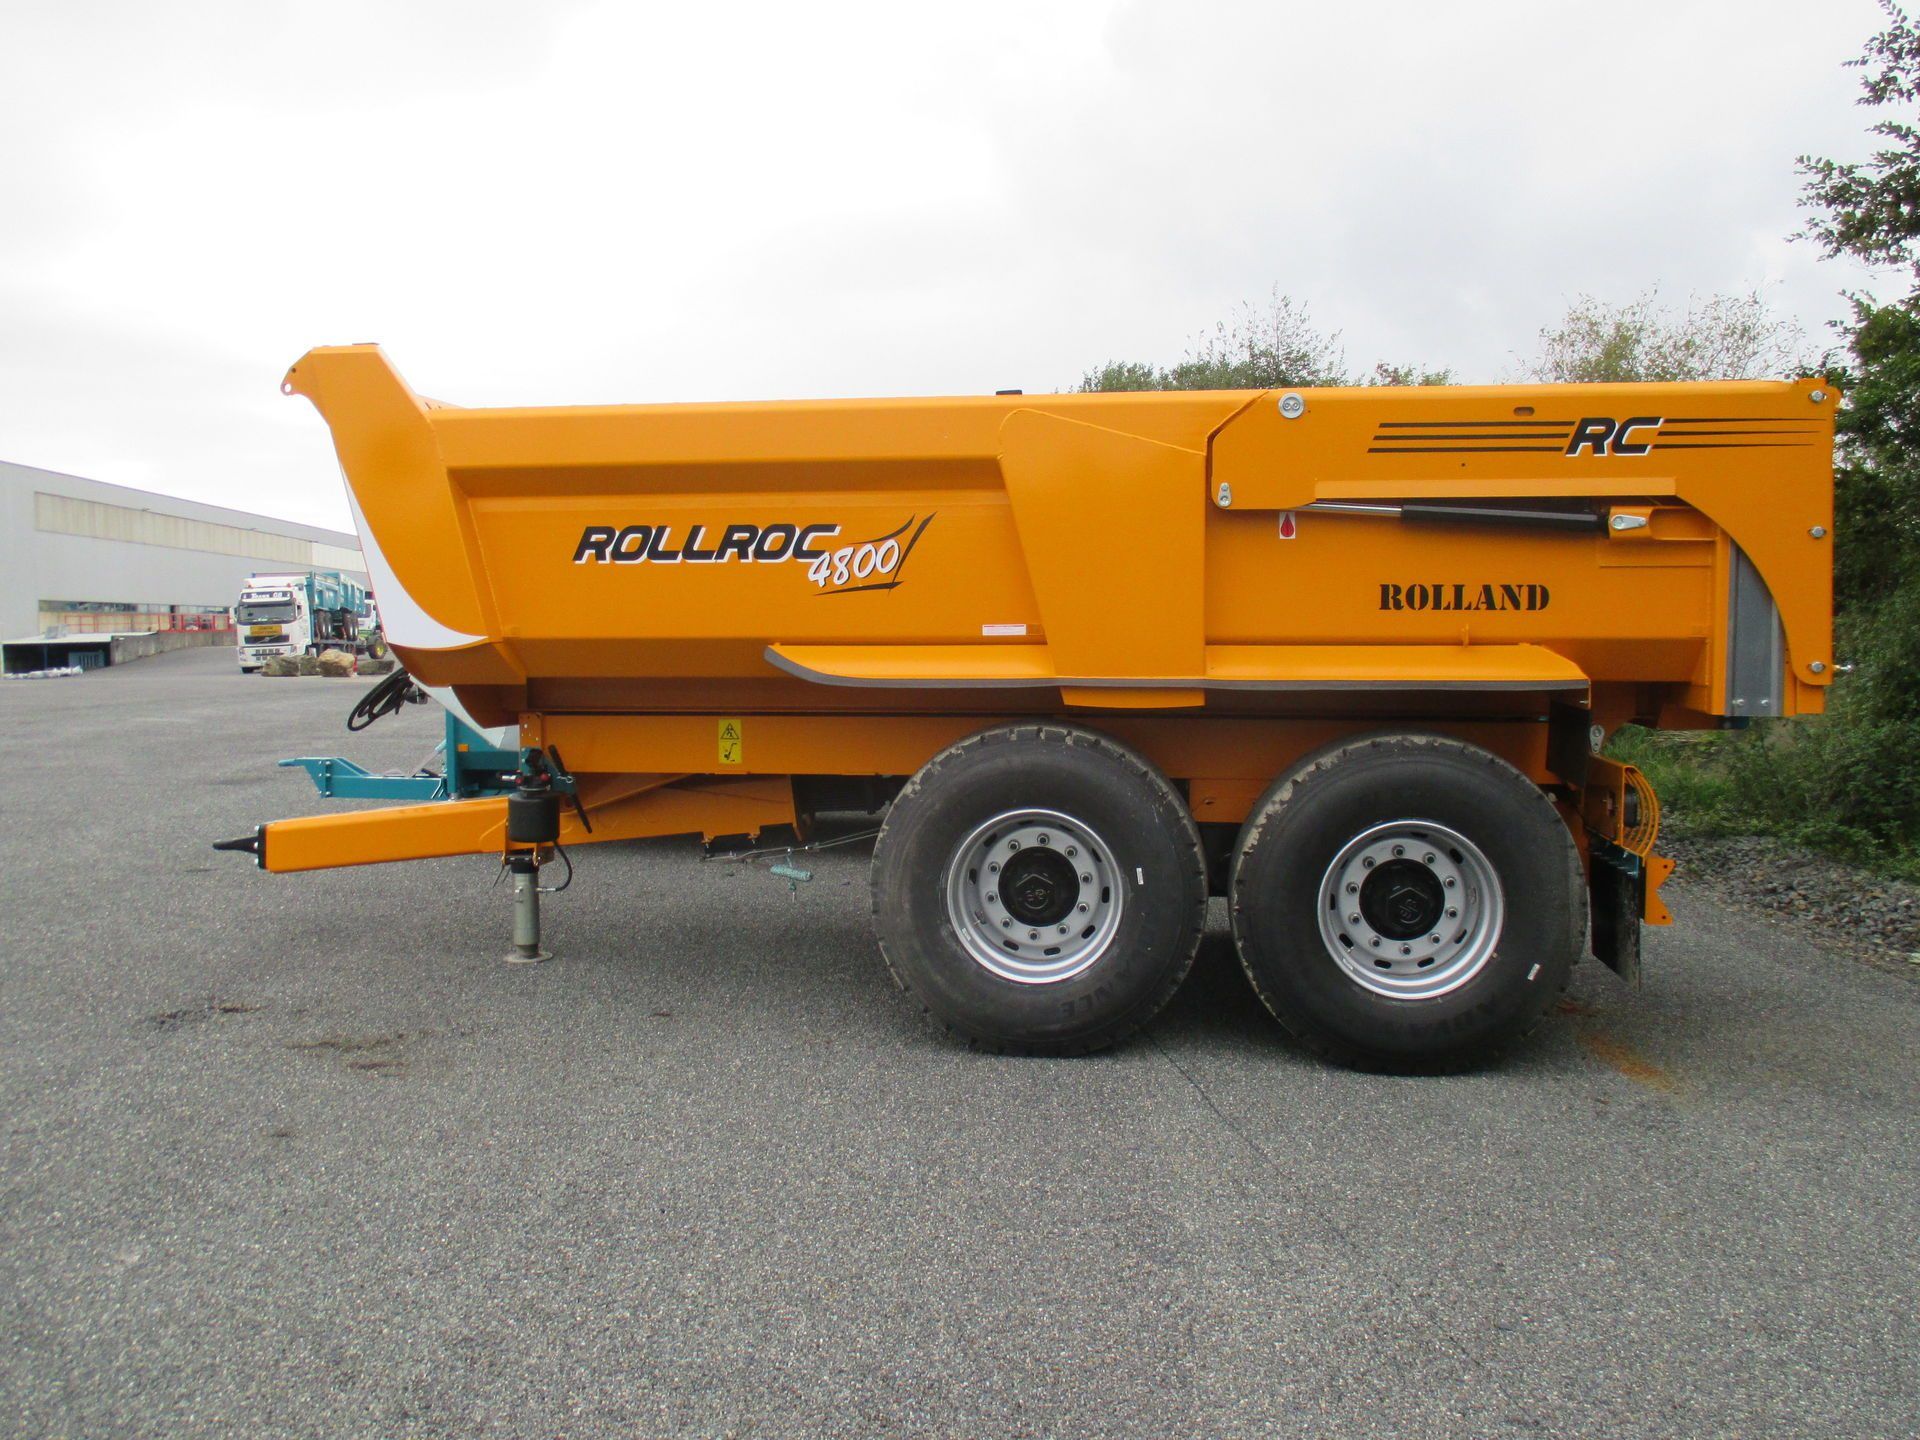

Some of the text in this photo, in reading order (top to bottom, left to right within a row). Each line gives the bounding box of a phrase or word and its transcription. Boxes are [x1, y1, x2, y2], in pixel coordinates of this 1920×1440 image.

[1565, 416, 1664, 457] RC
[572, 523, 842, 564] ROLLROC
[808, 539, 900, 587] 4800
[1379, 584, 1550, 610] ROLLAND
